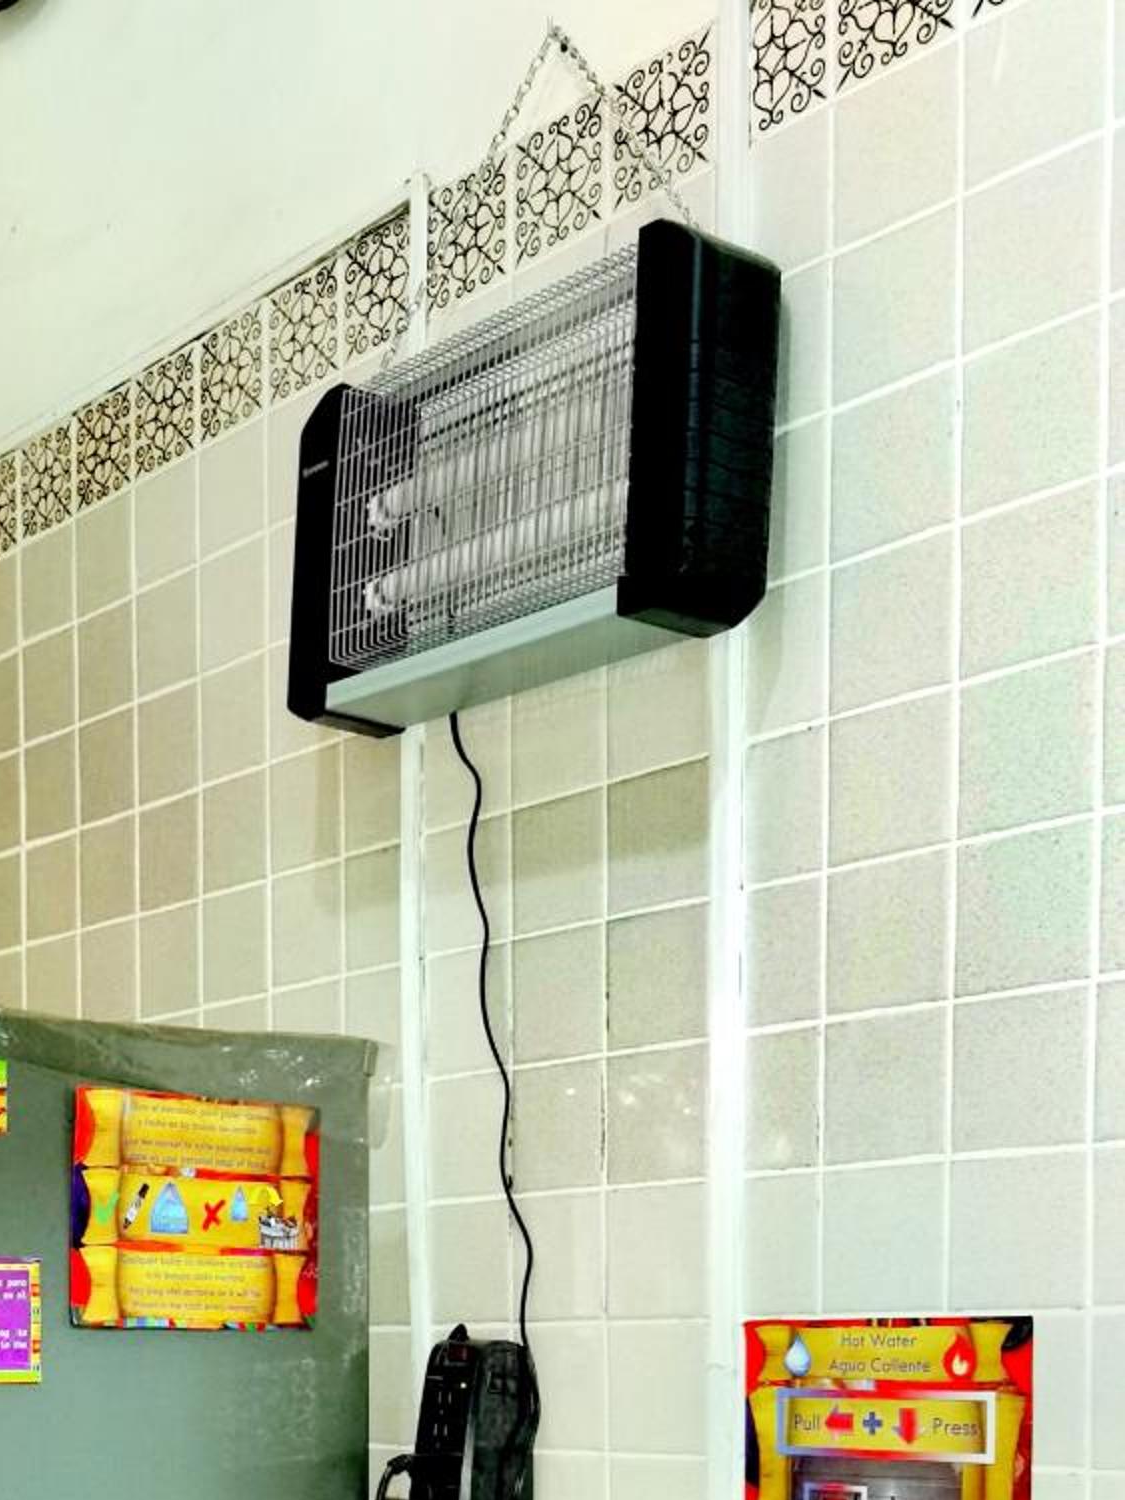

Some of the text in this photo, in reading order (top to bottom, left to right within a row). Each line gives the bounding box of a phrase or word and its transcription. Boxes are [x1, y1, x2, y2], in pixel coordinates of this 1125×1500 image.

[841, 1334, 918, 1347] Hot Water
[828, 1357, 931, 1376] Agua Caliente
[794, 1413, 980, 1436] Pull Press
